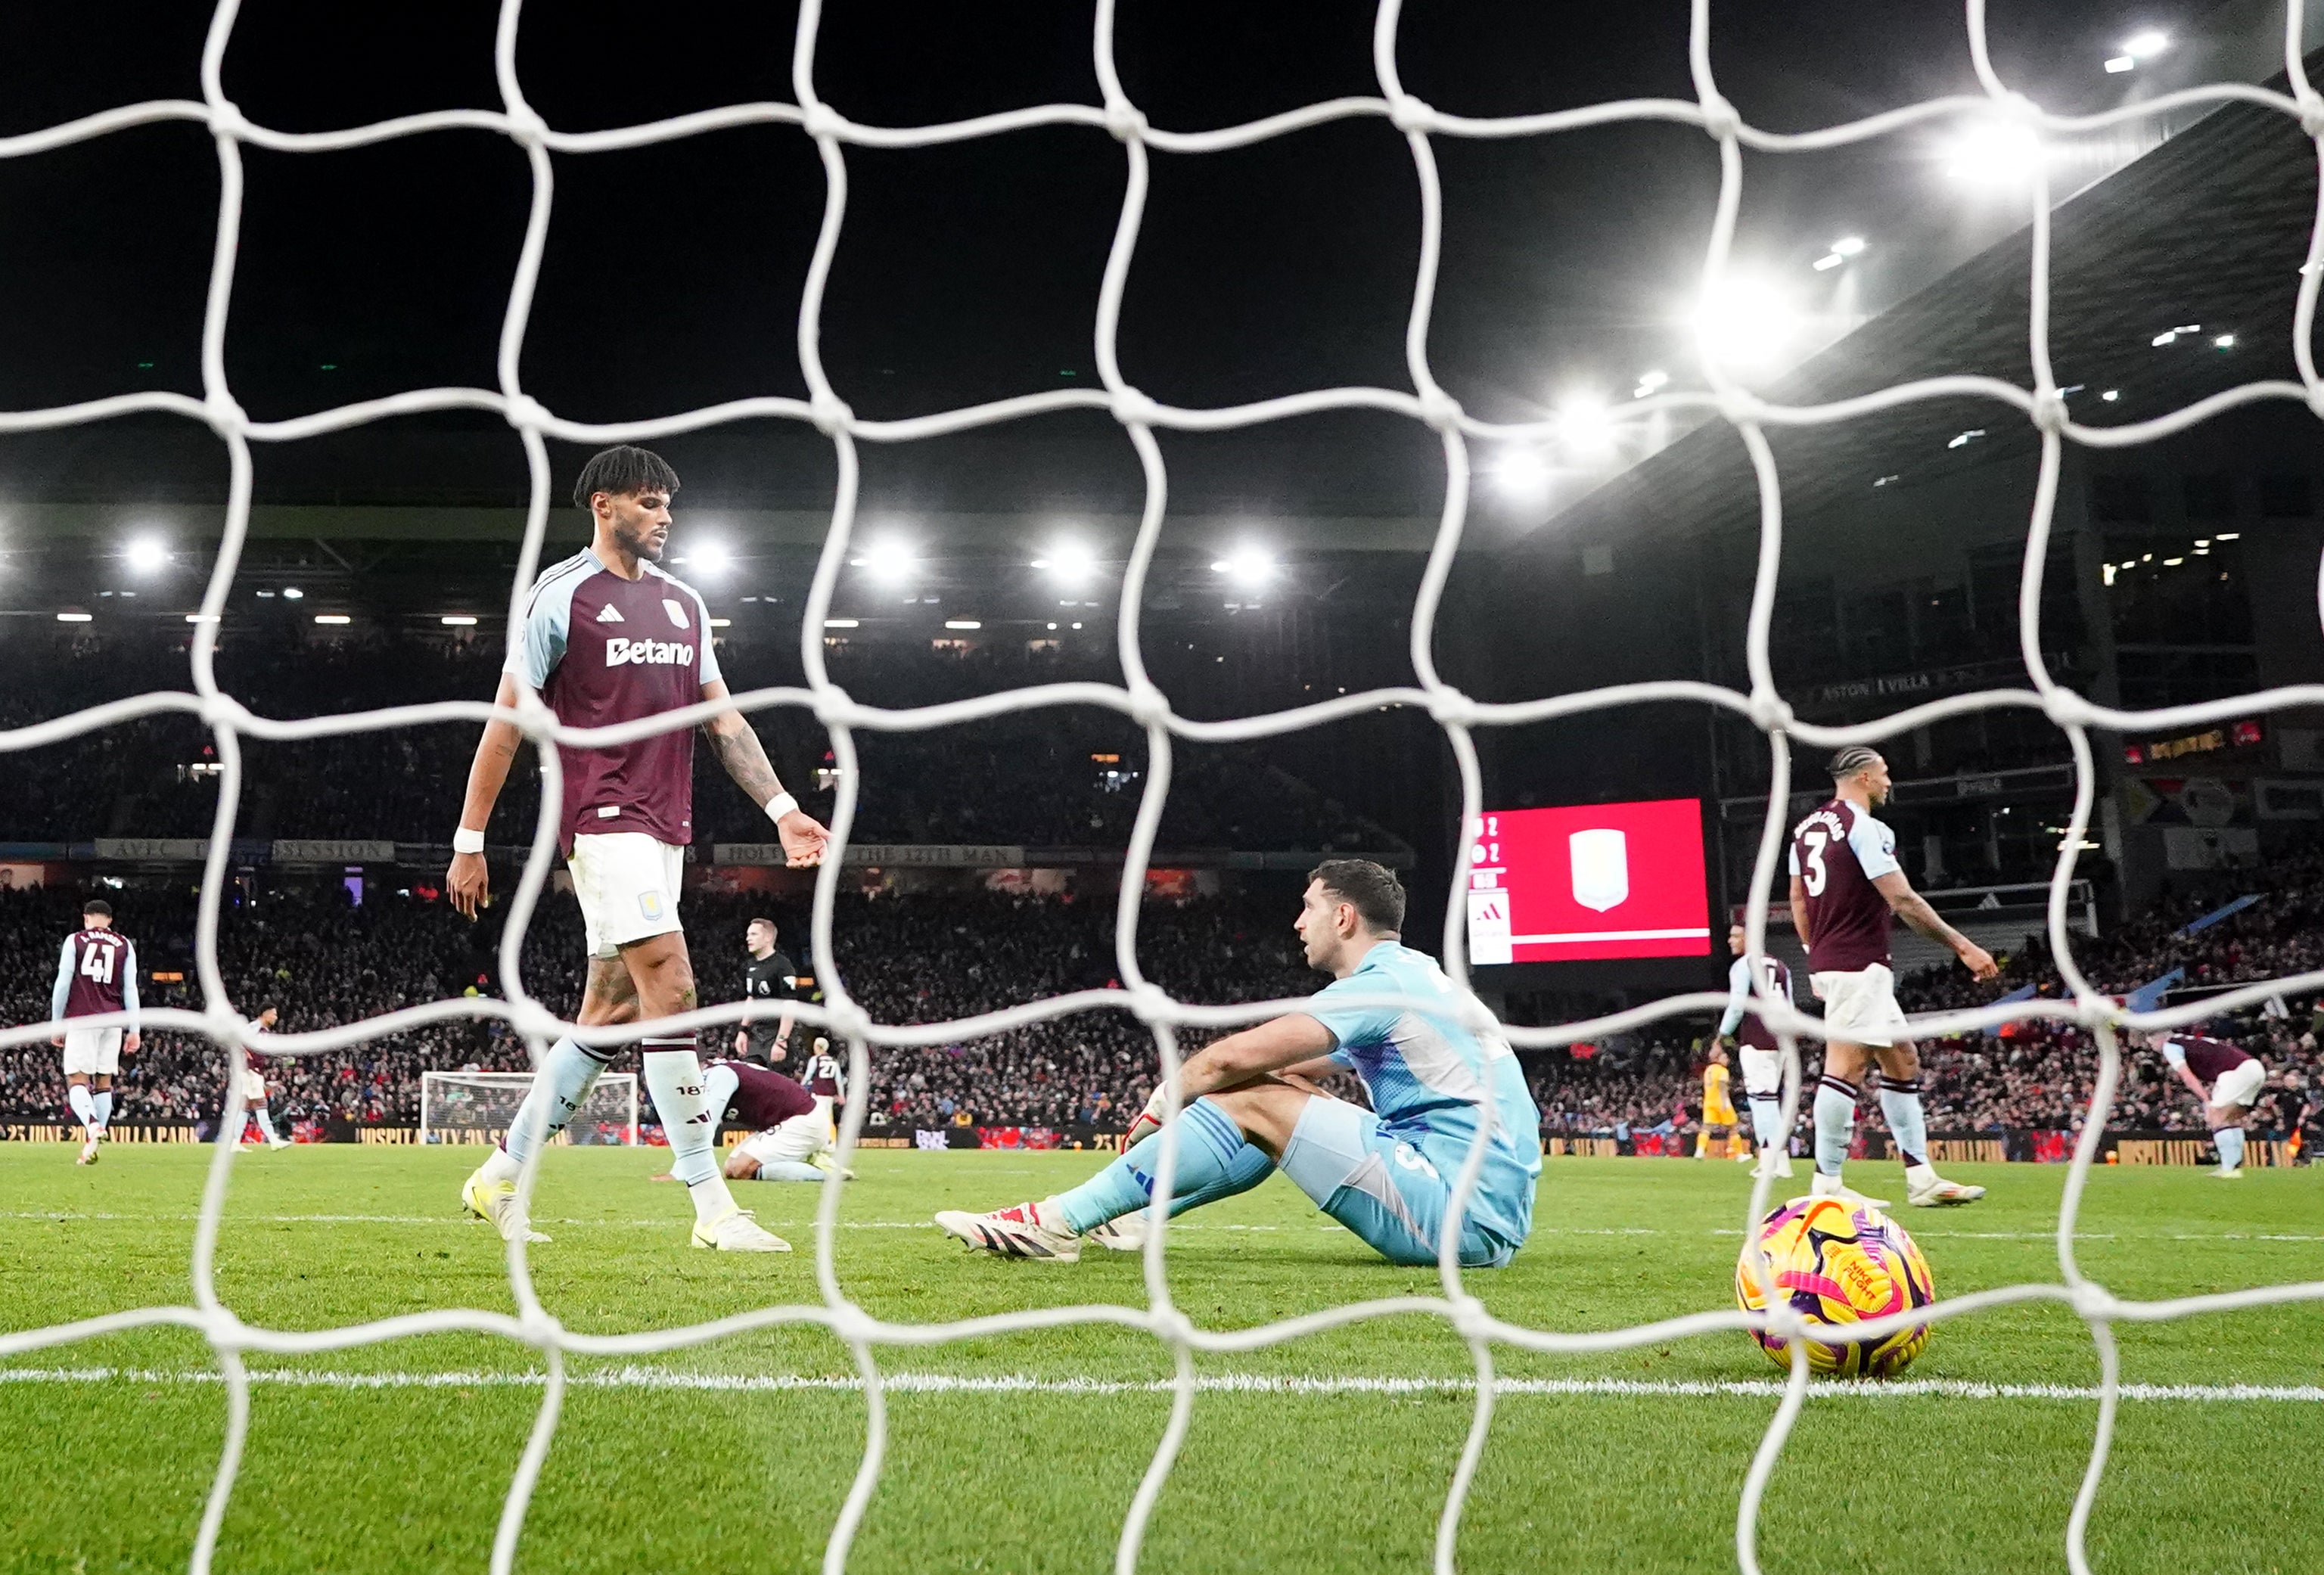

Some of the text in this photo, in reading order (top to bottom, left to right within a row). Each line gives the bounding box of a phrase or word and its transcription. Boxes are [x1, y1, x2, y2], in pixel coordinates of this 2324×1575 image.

[606, 638, 694, 667] Betano
[1487, 817, 1498, 837] 2
[856, 847, 893, 862] THE
[963, 847, 1008, 863] MAN
[1489, 843, 1499, 862] 2
[1804, 832, 1828, 897] 3
[81, 943, 115, 984] 41
[109, 1125, 153, 1145] VILLA
[157, 1125, 200, 1145] PARK
[1843, 1266, 1877, 1300] FLIGHT
[1850, 1260, 1874, 1286] NIKE
